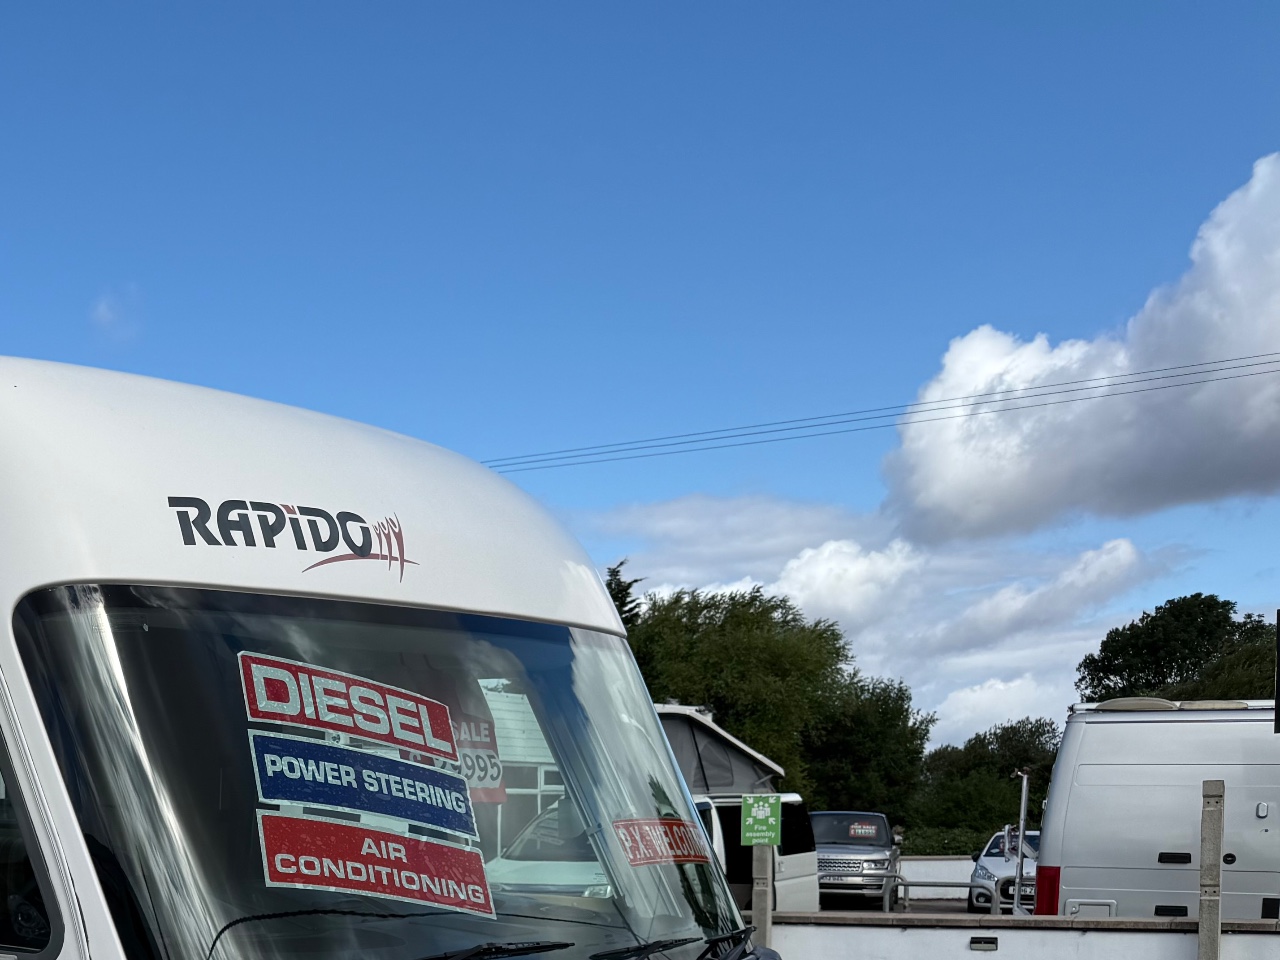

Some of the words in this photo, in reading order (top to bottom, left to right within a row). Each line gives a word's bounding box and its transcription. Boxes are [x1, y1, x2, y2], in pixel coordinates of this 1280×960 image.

[250, 663, 454, 753] DIESEL
[452, 721, 490, 743] SALE
[264, 753, 358, 789] POWER
[364, 768, 467, 815] STEERING
[360, 837, 408, 863] AIR
[274, 852, 486, 904] CONDITIONING
